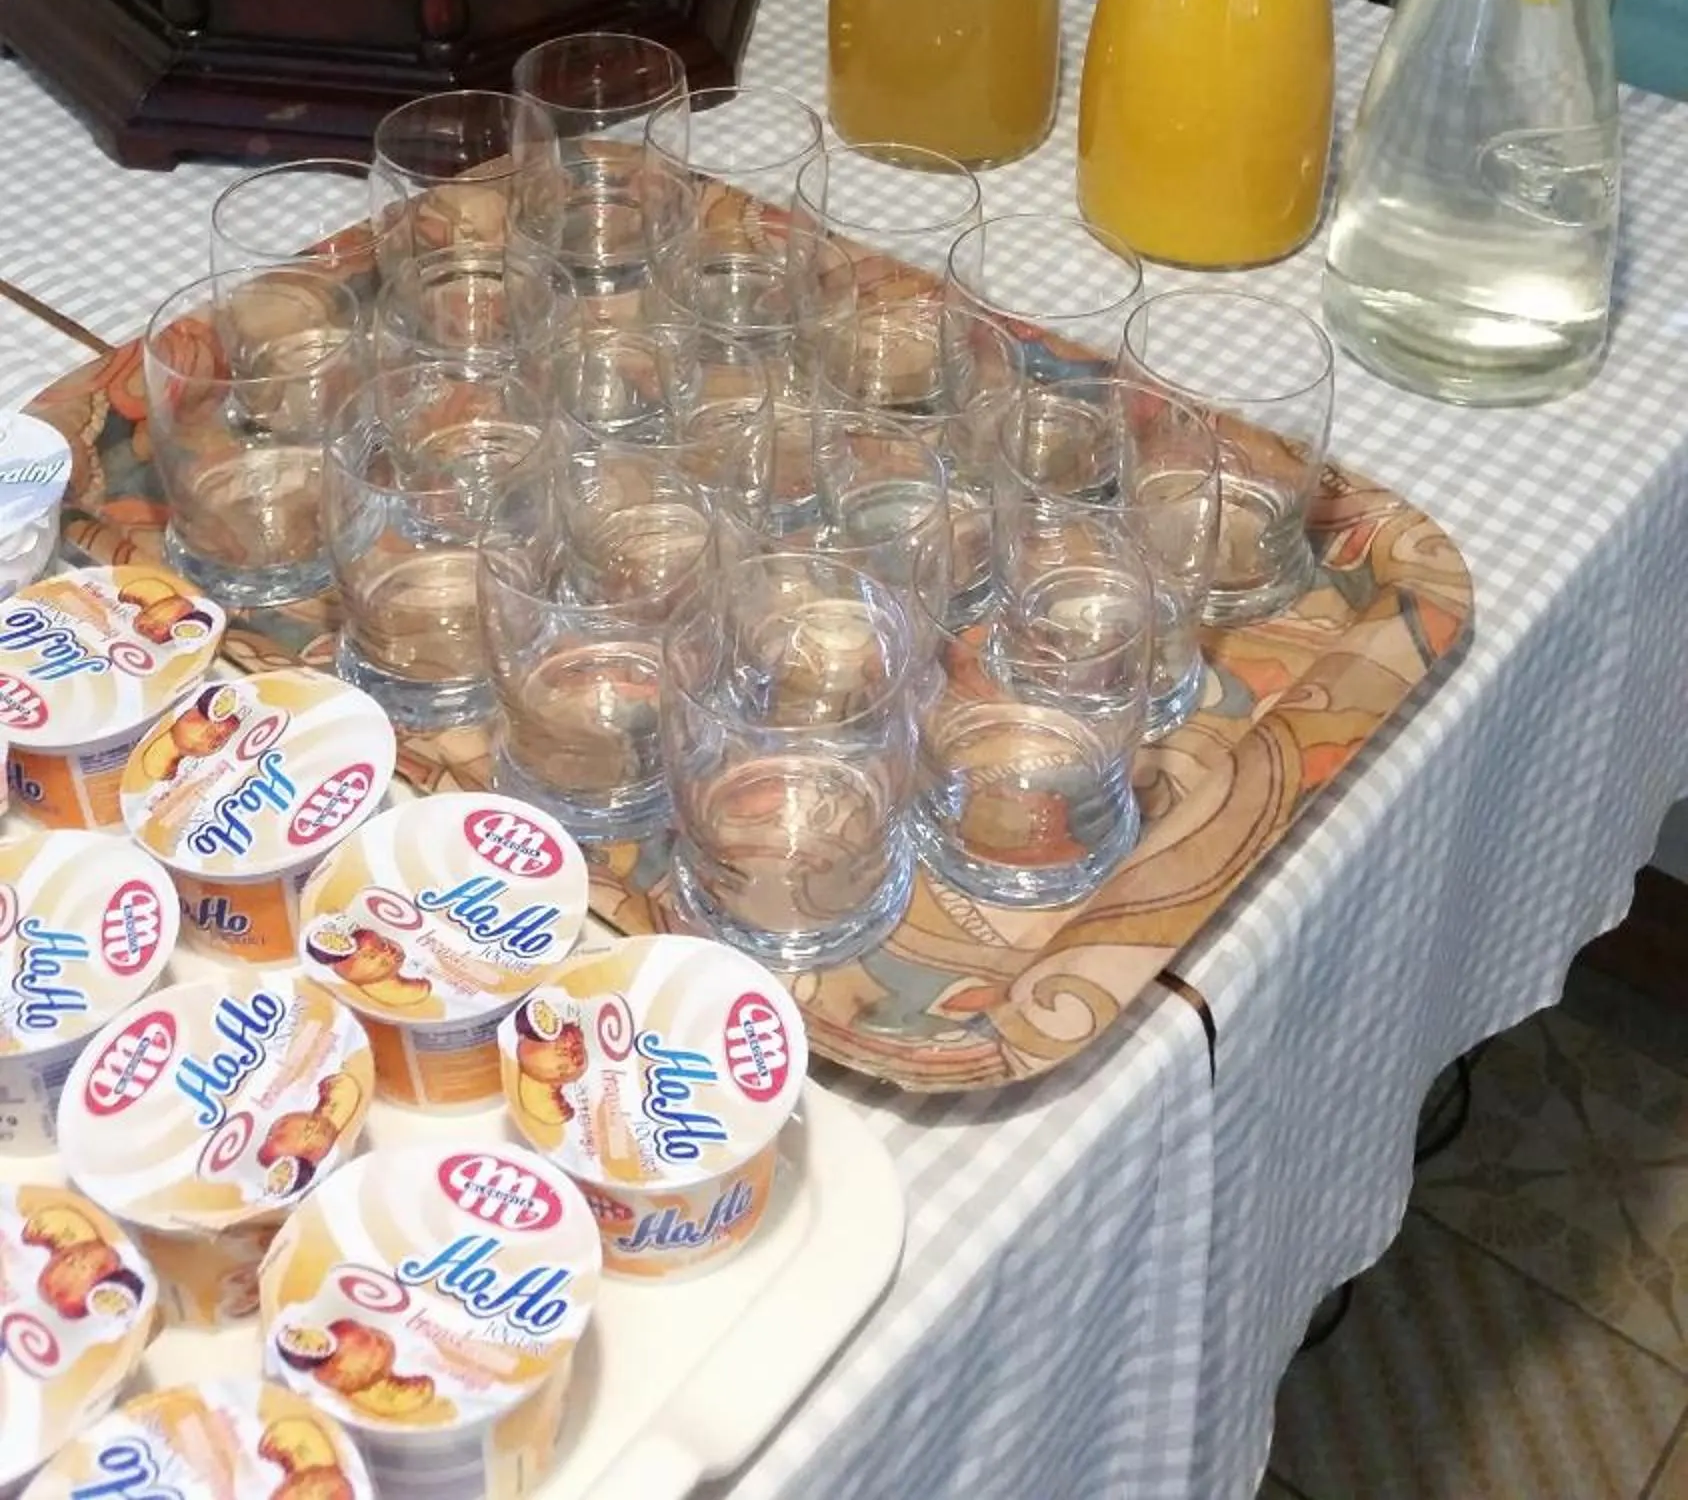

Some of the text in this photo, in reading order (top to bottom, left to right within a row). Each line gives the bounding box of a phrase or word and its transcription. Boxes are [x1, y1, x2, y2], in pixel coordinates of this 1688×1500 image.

[194, 752, 296, 856] HoHo
[420, 874, 561, 954] HoHo
[21, 918, 90, 1029] HoHo
[175, 993, 278, 1126] HoHo
[642, 1032, 729, 1160] HoHo
[402, 1233, 570, 1328] HoHo
